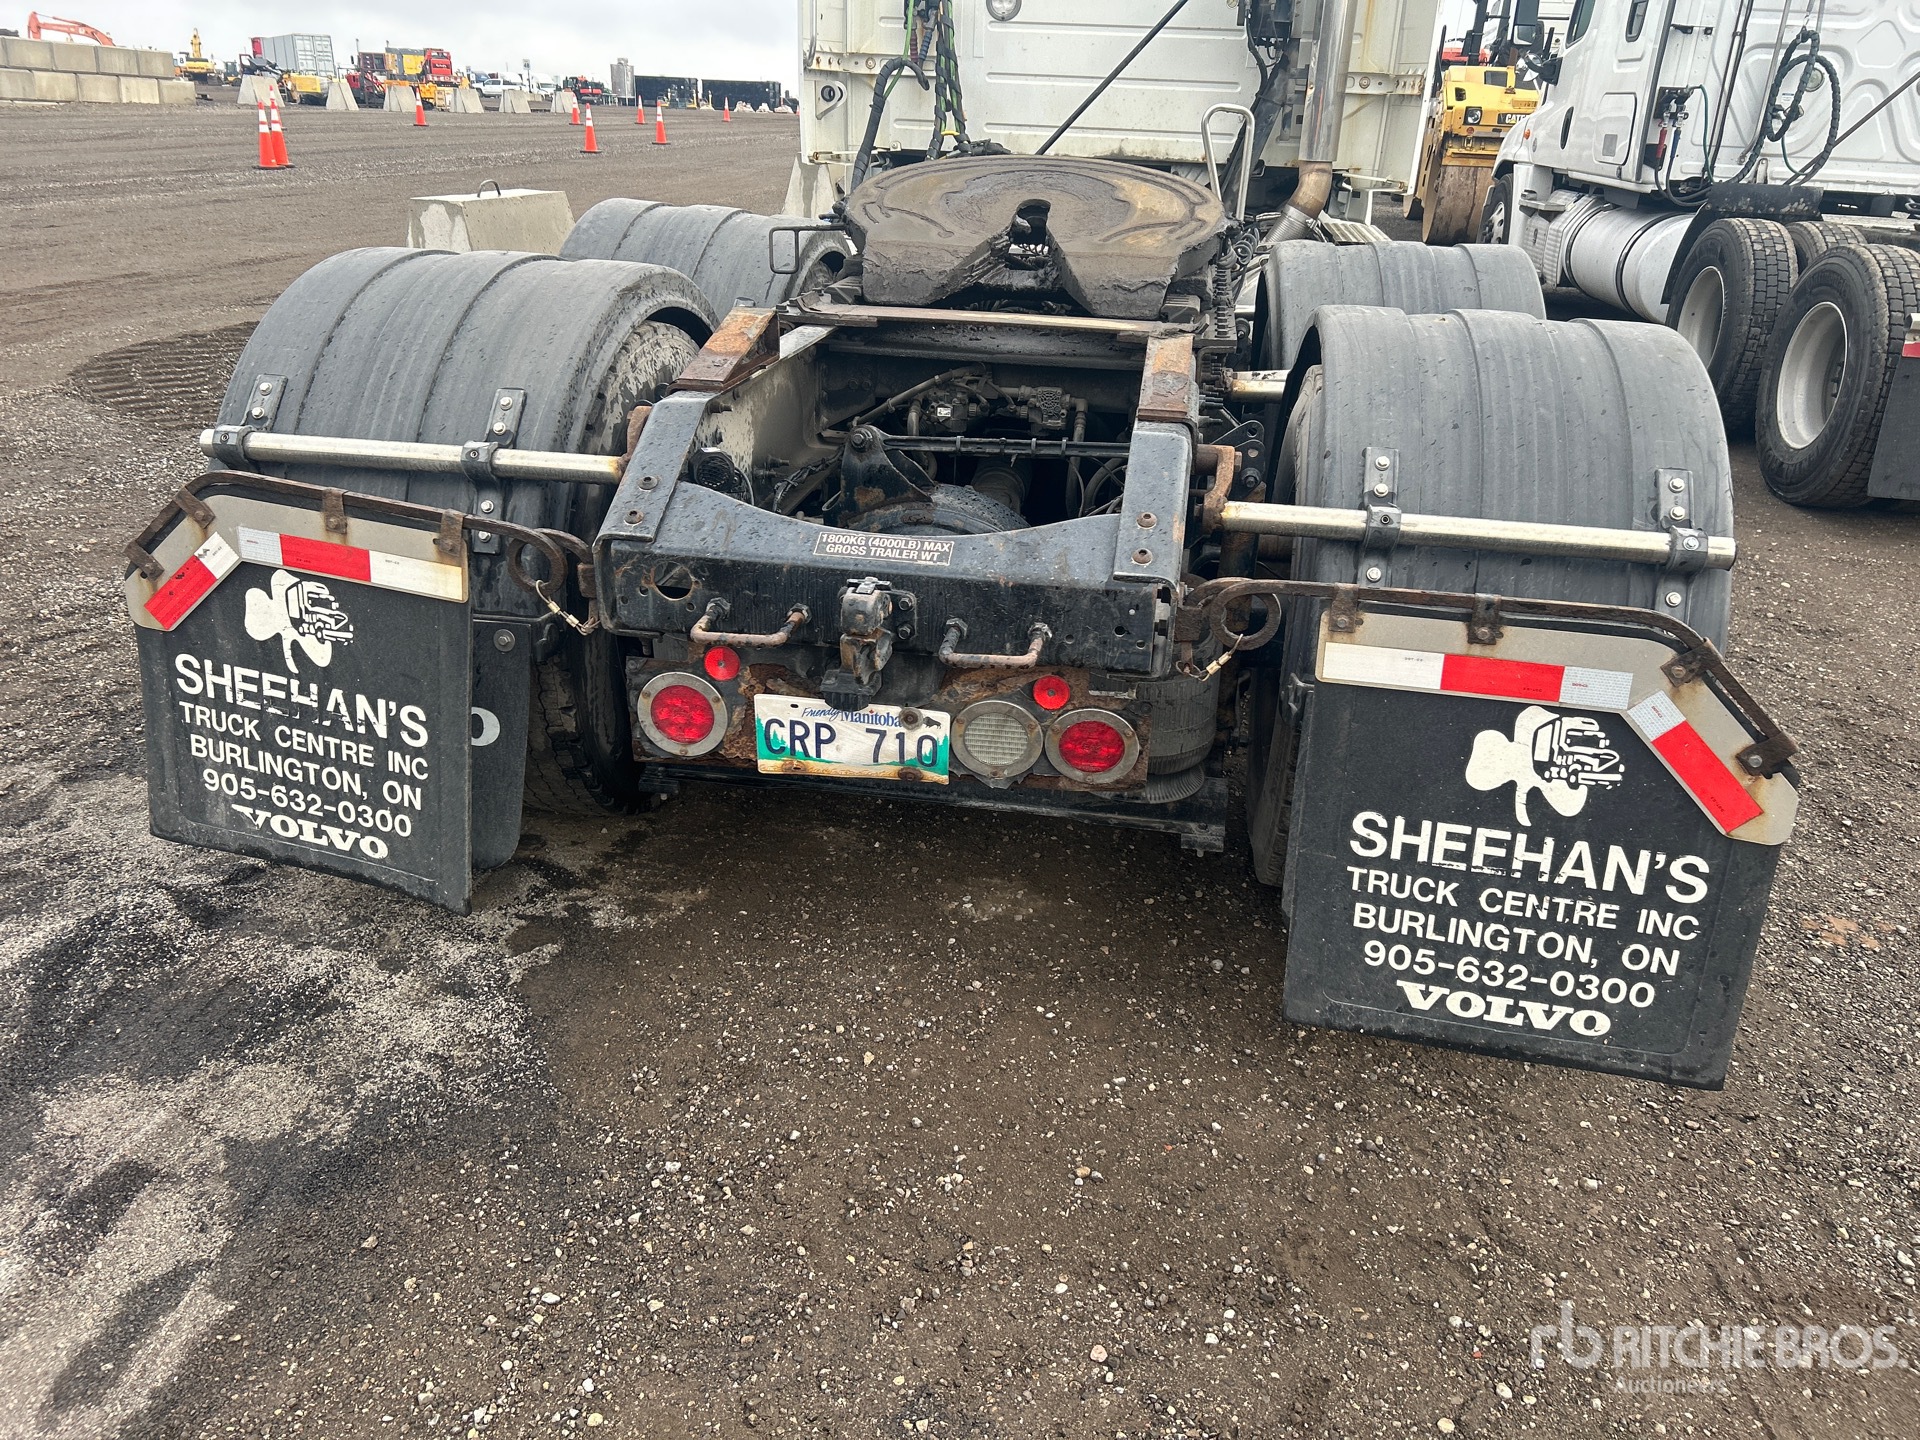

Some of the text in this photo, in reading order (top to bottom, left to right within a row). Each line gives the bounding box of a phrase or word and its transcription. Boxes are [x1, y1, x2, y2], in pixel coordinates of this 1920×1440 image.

[822, 534, 951, 552] 1800KG (4000LB) MAX
[826, 544, 940, 561] GROSS TRAILER WT
[175, 653, 428, 748] SHEEHAN'S
[801, 706, 901, 728] Friendly Manitoba
[179, 701, 428, 780] TRUCK CENTRE INC
[190, 733, 422, 810] BURLINGTON, ON
[764, 718, 938, 768] CRP 710
[203, 769, 412, 837] 905-632-0300
[231, 803, 389, 859] VOLVO
[1350, 811, 1710, 904] SHEEHAN'S
[1347, 866, 1700, 941] TRUCK CENTRE INC
[1353, 902, 1680, 976] BURLINGTON, ON
[1364, 940, 1656, 1008] 905-632-0300
[1396, 980, 1612, 1037] VOLVO
